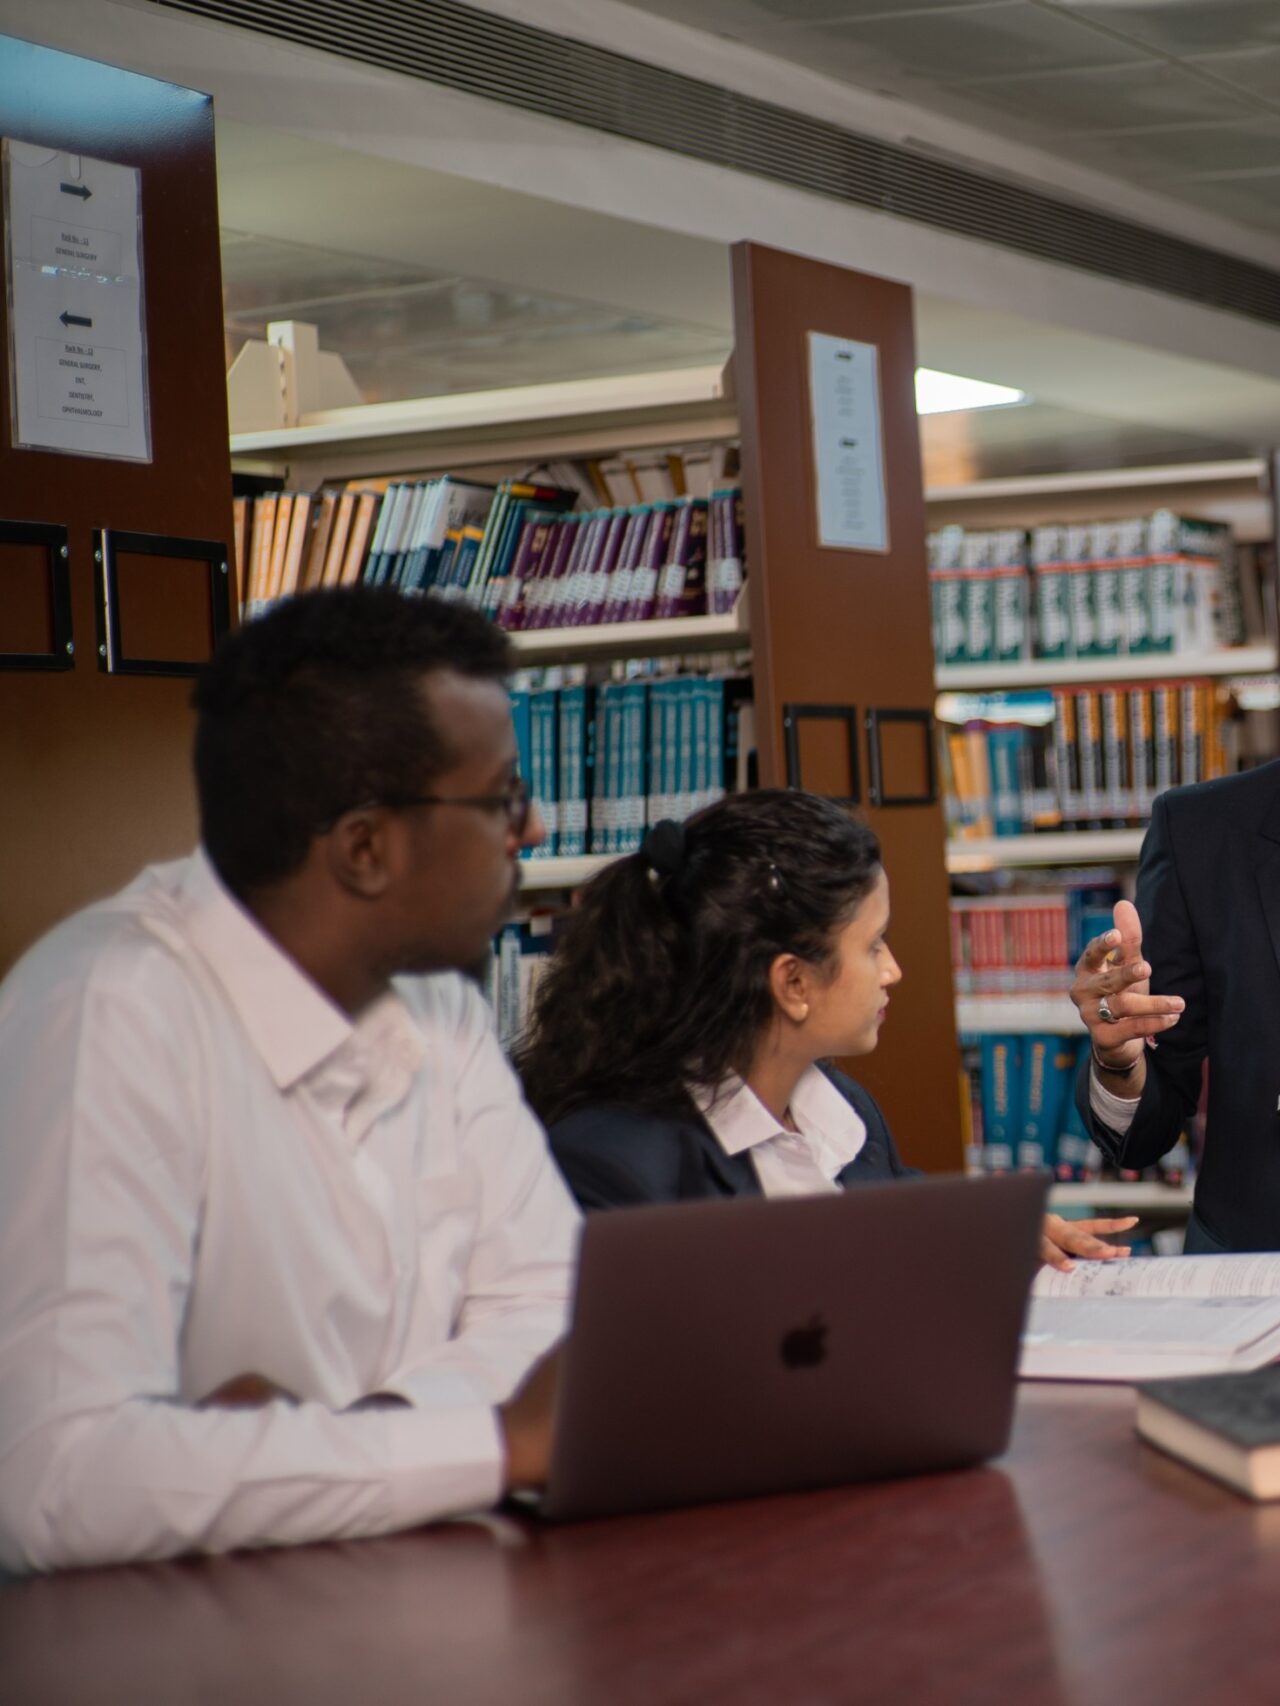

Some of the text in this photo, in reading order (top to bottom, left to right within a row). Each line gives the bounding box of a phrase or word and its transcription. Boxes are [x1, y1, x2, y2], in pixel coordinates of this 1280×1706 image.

[55, 247, 97, 261] GENERAL SURGERY
[59, 359, 79, 368] GENERAL
